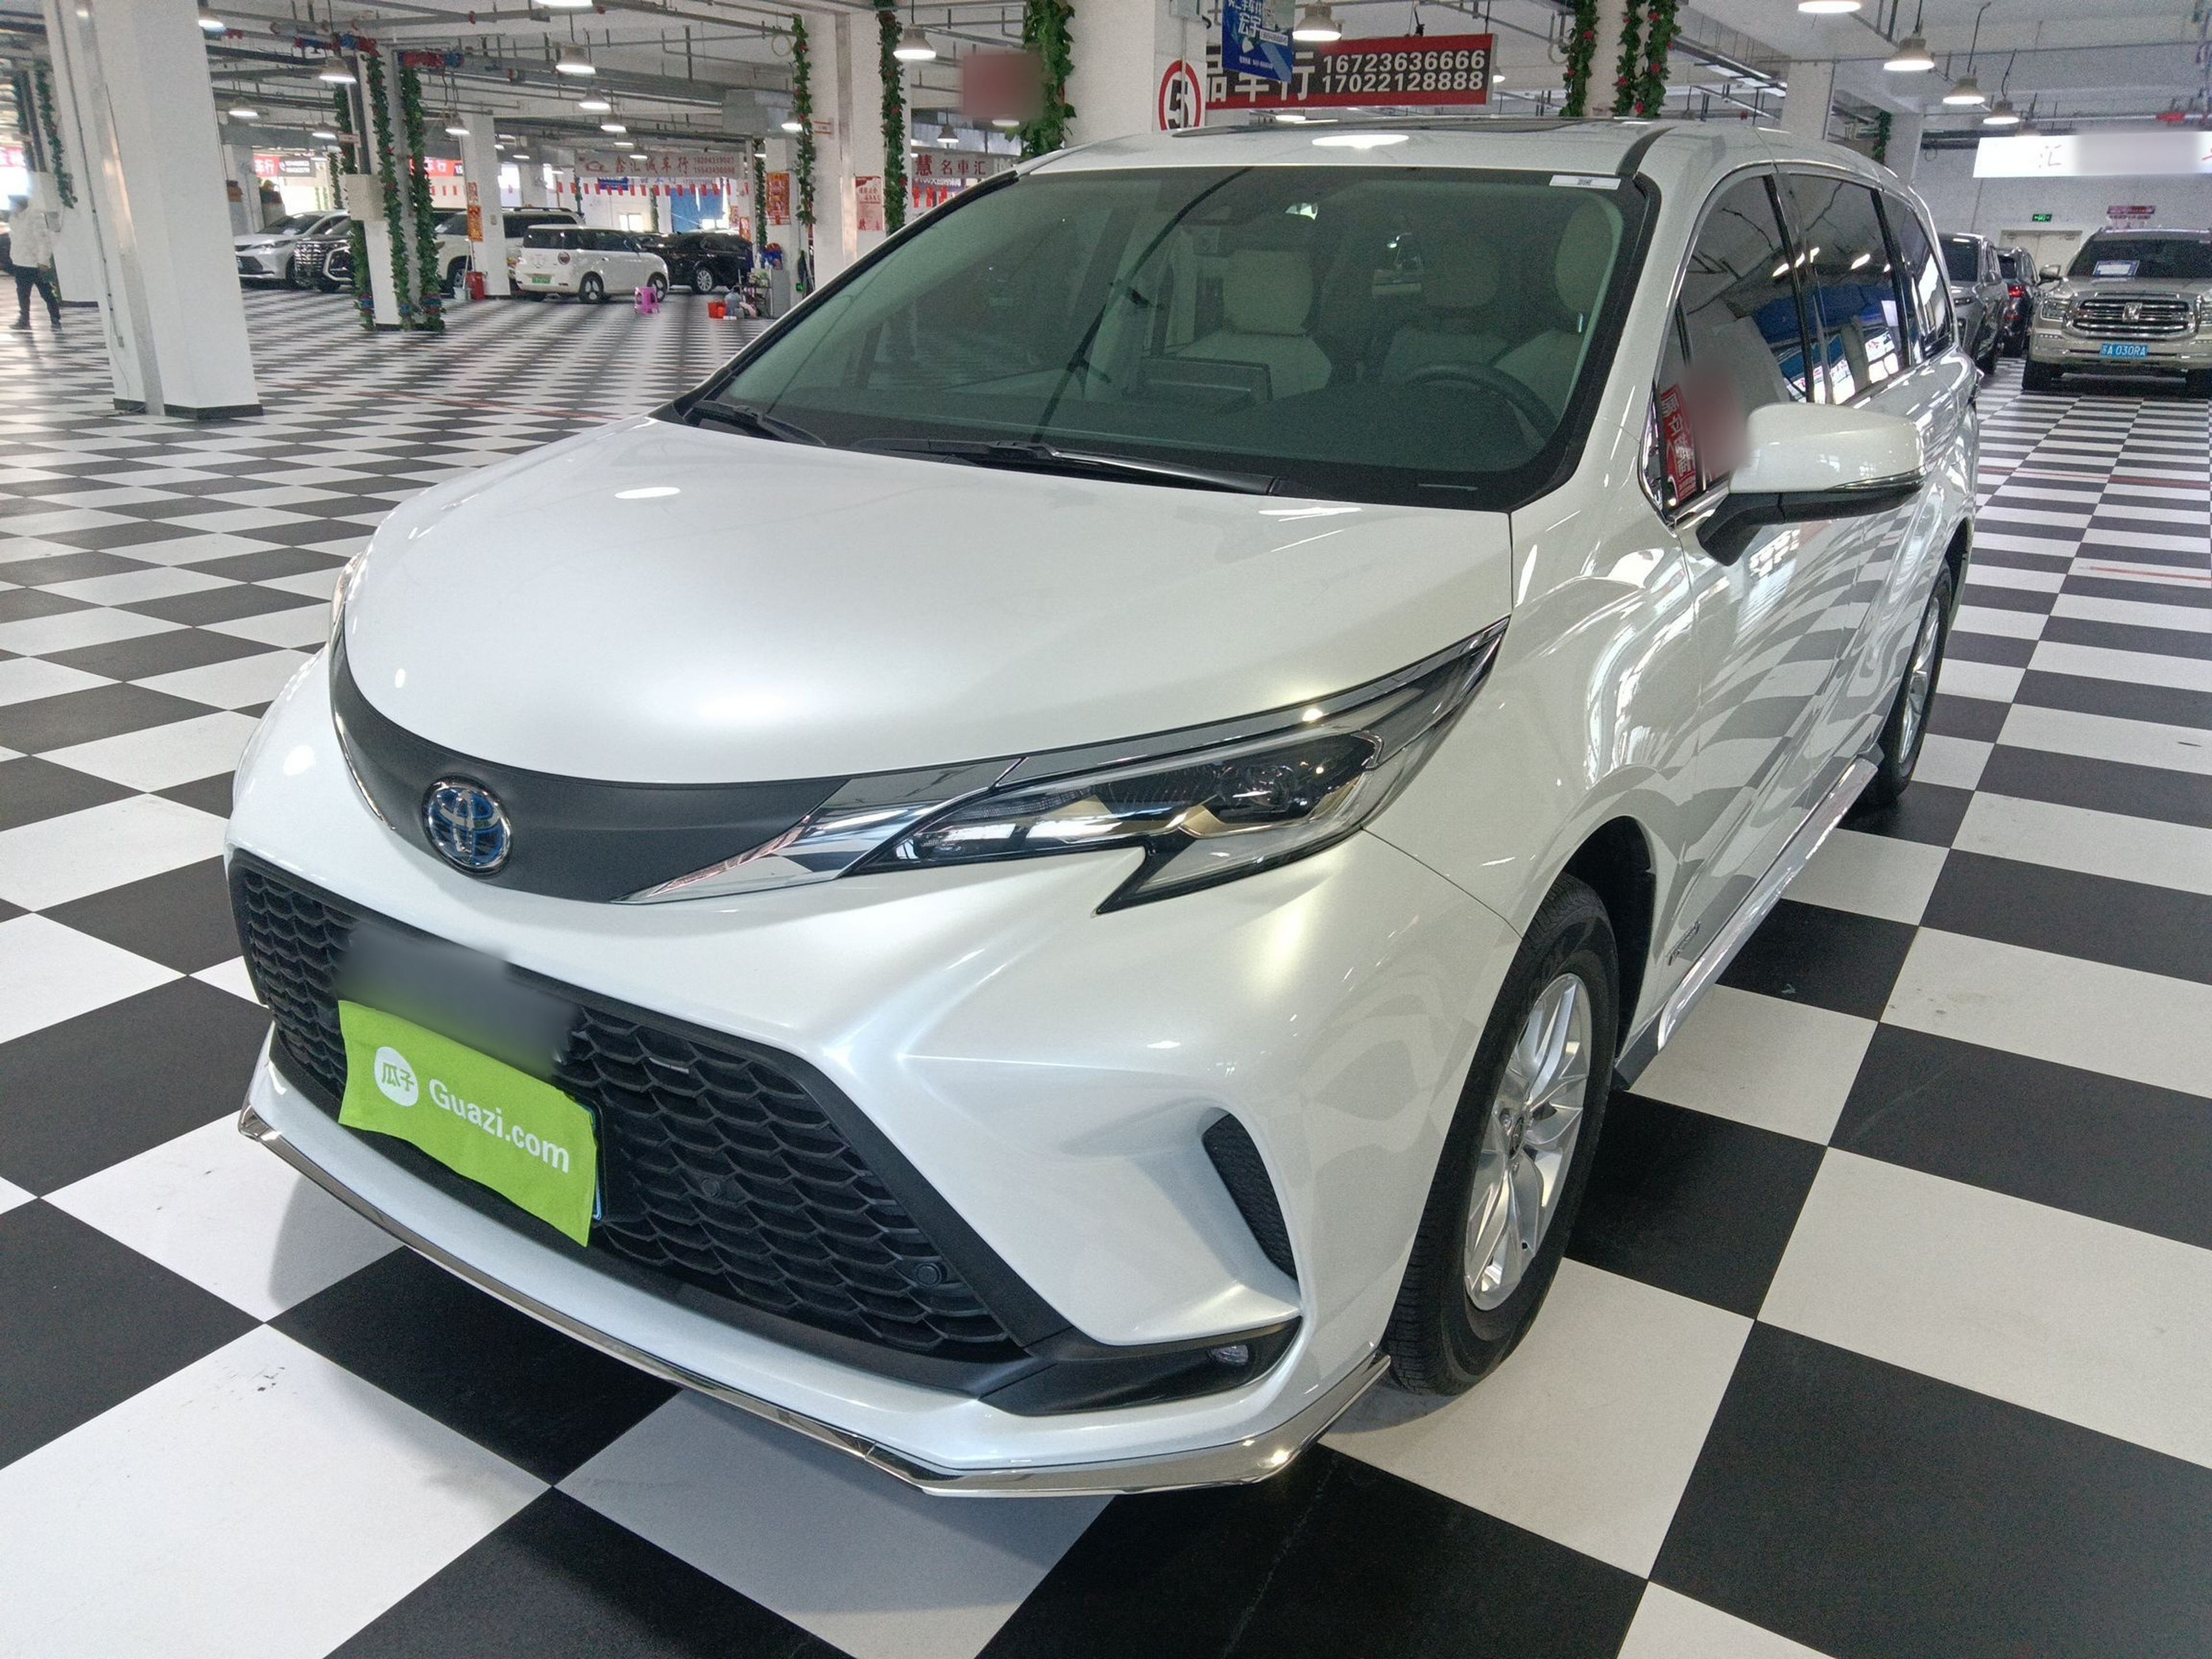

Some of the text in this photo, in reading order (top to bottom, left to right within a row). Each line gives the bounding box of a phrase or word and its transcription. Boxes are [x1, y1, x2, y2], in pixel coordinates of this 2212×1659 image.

[1323, 50, 1485, 74] 16723636666
[1322, 71, 1483, 93] 17022128888
[382, 1062, 414, 1092] 瓜子
[429, 1079, 569, 1173] Guazi.com
